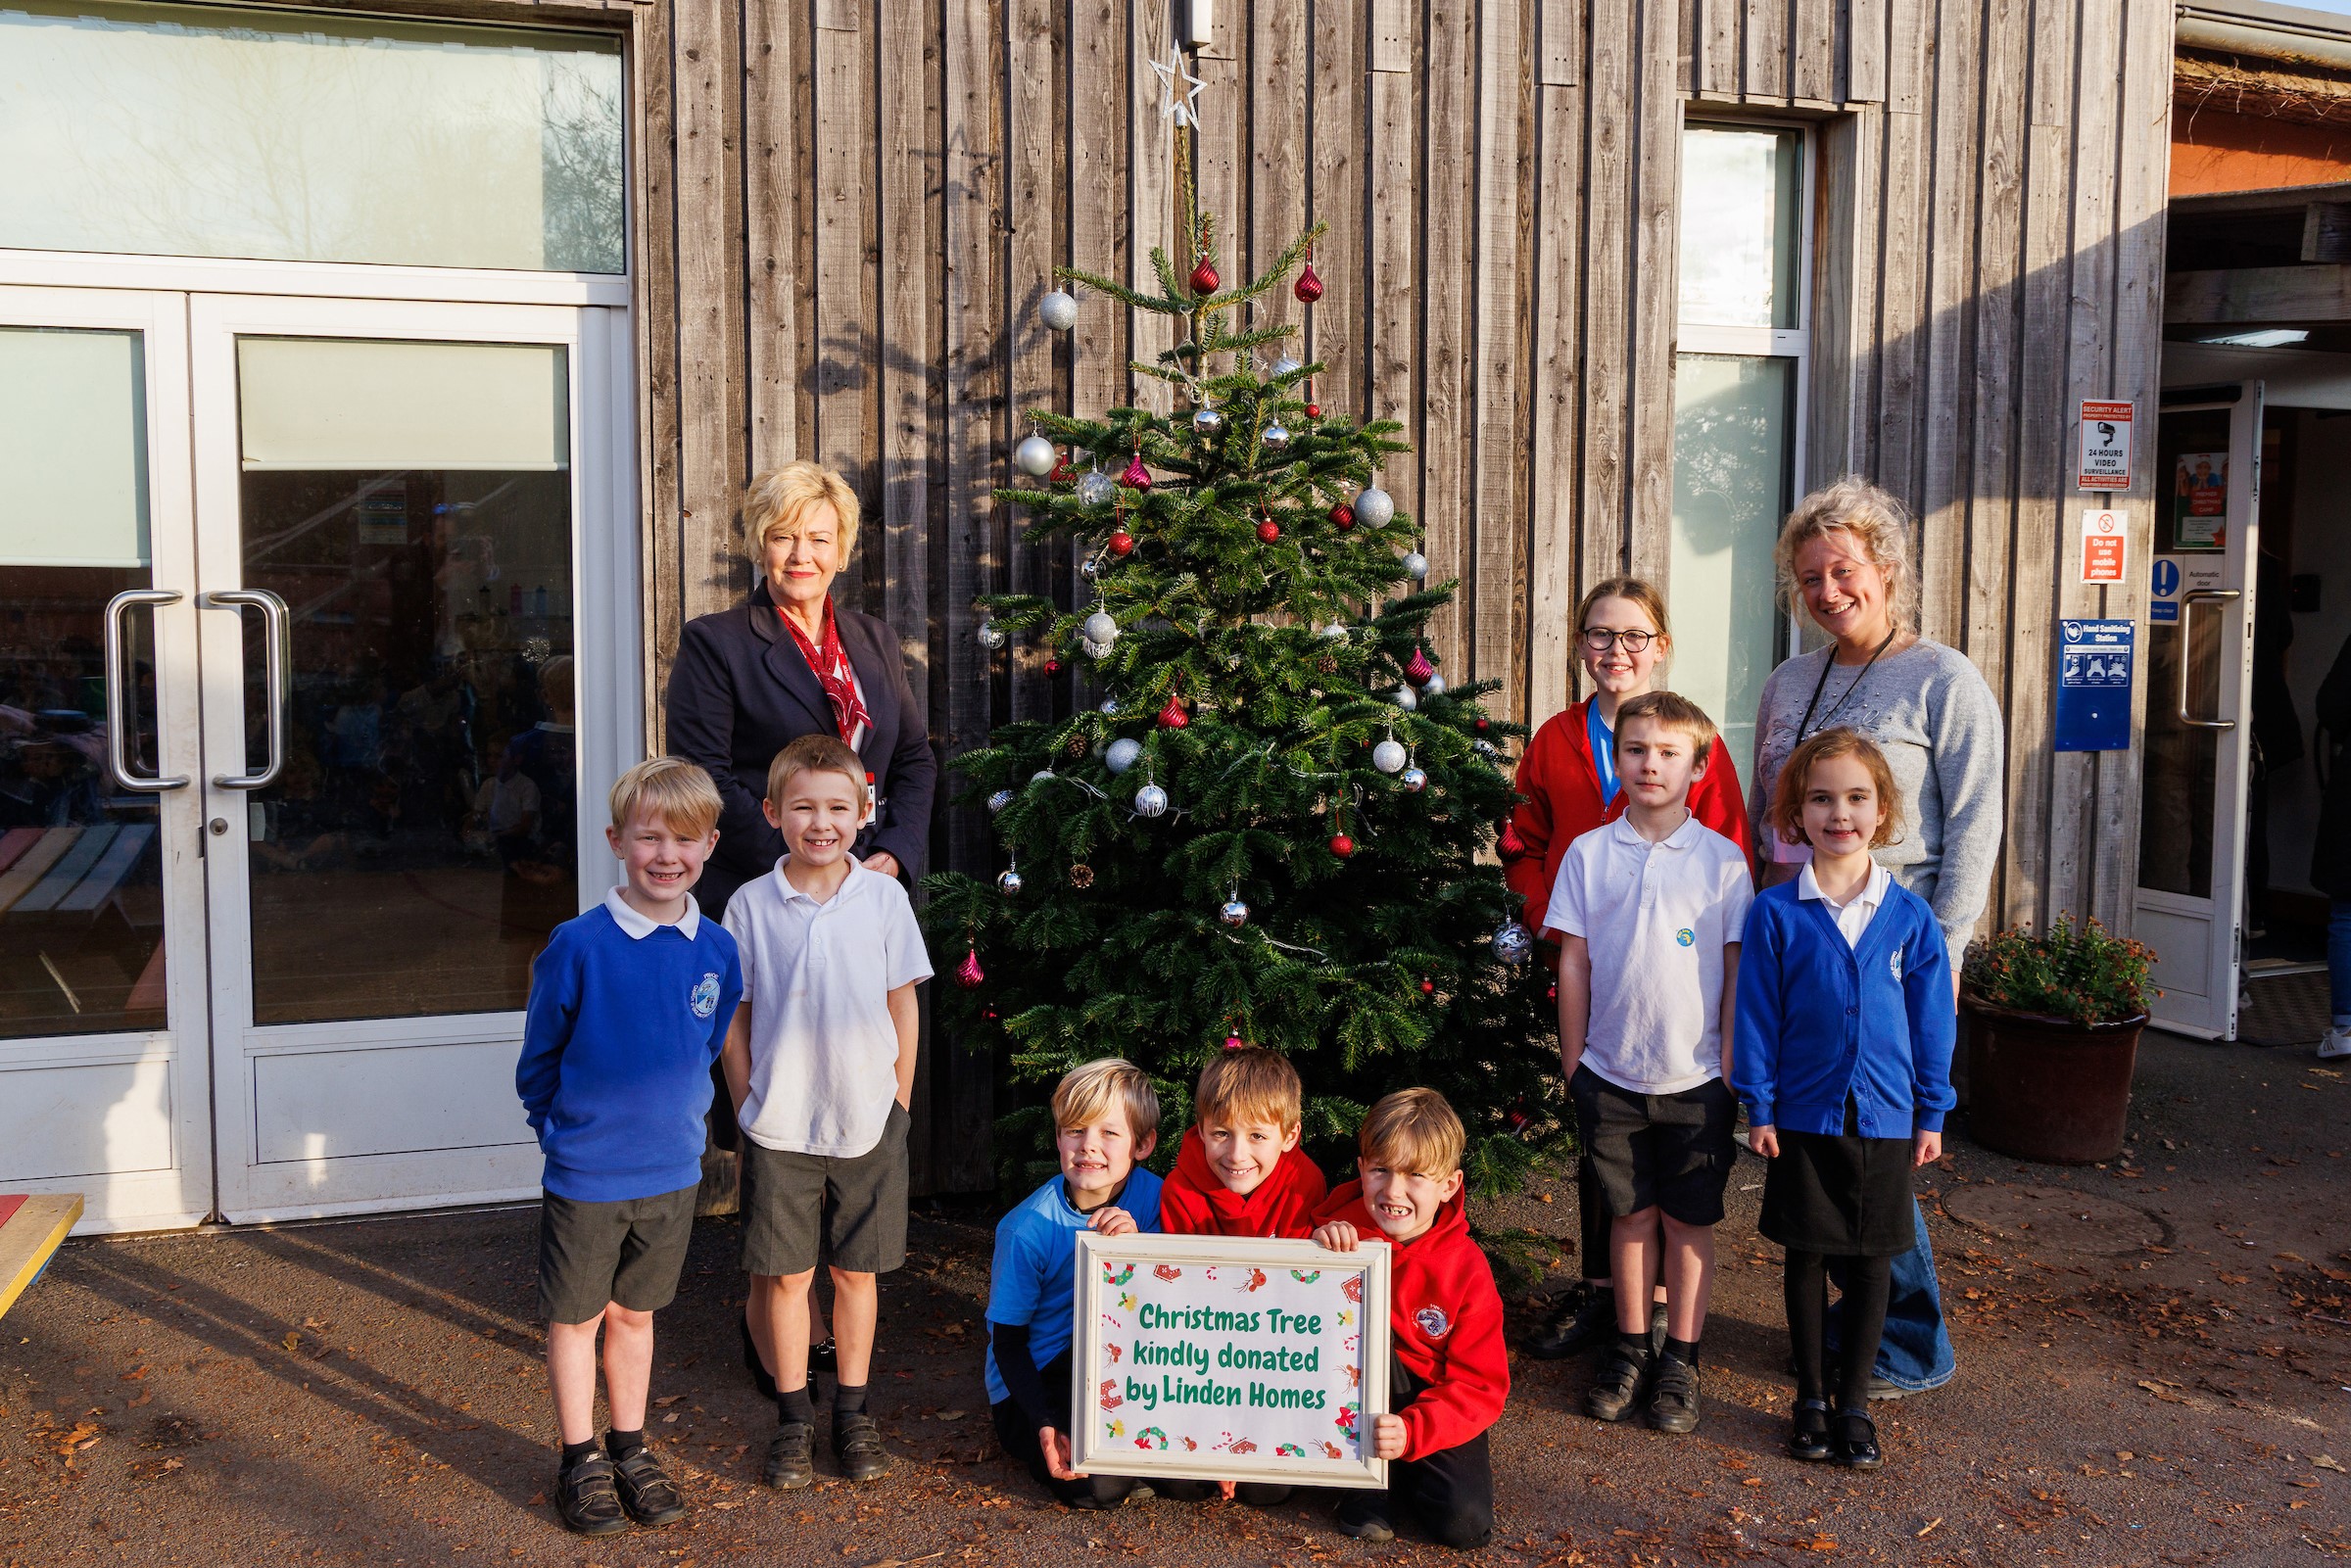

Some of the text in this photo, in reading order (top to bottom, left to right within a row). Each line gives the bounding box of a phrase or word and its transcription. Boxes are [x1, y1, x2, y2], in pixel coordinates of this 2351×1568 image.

[2092, 538, 2104, 546] Do
[2092, 558, 2116, 566] mobile
[2090, 568, 2117, 578] phones
[2083, 624, 2131, 635] Hand Sanitising
[2095, 634, 2118, 642] Station
[1139, 1303, 1322, 1334] Christmas Tree
[1133, 1339, 1319, 1376] kindly donated
[1126, 1374, 1326, 1411] by Linden Homes
